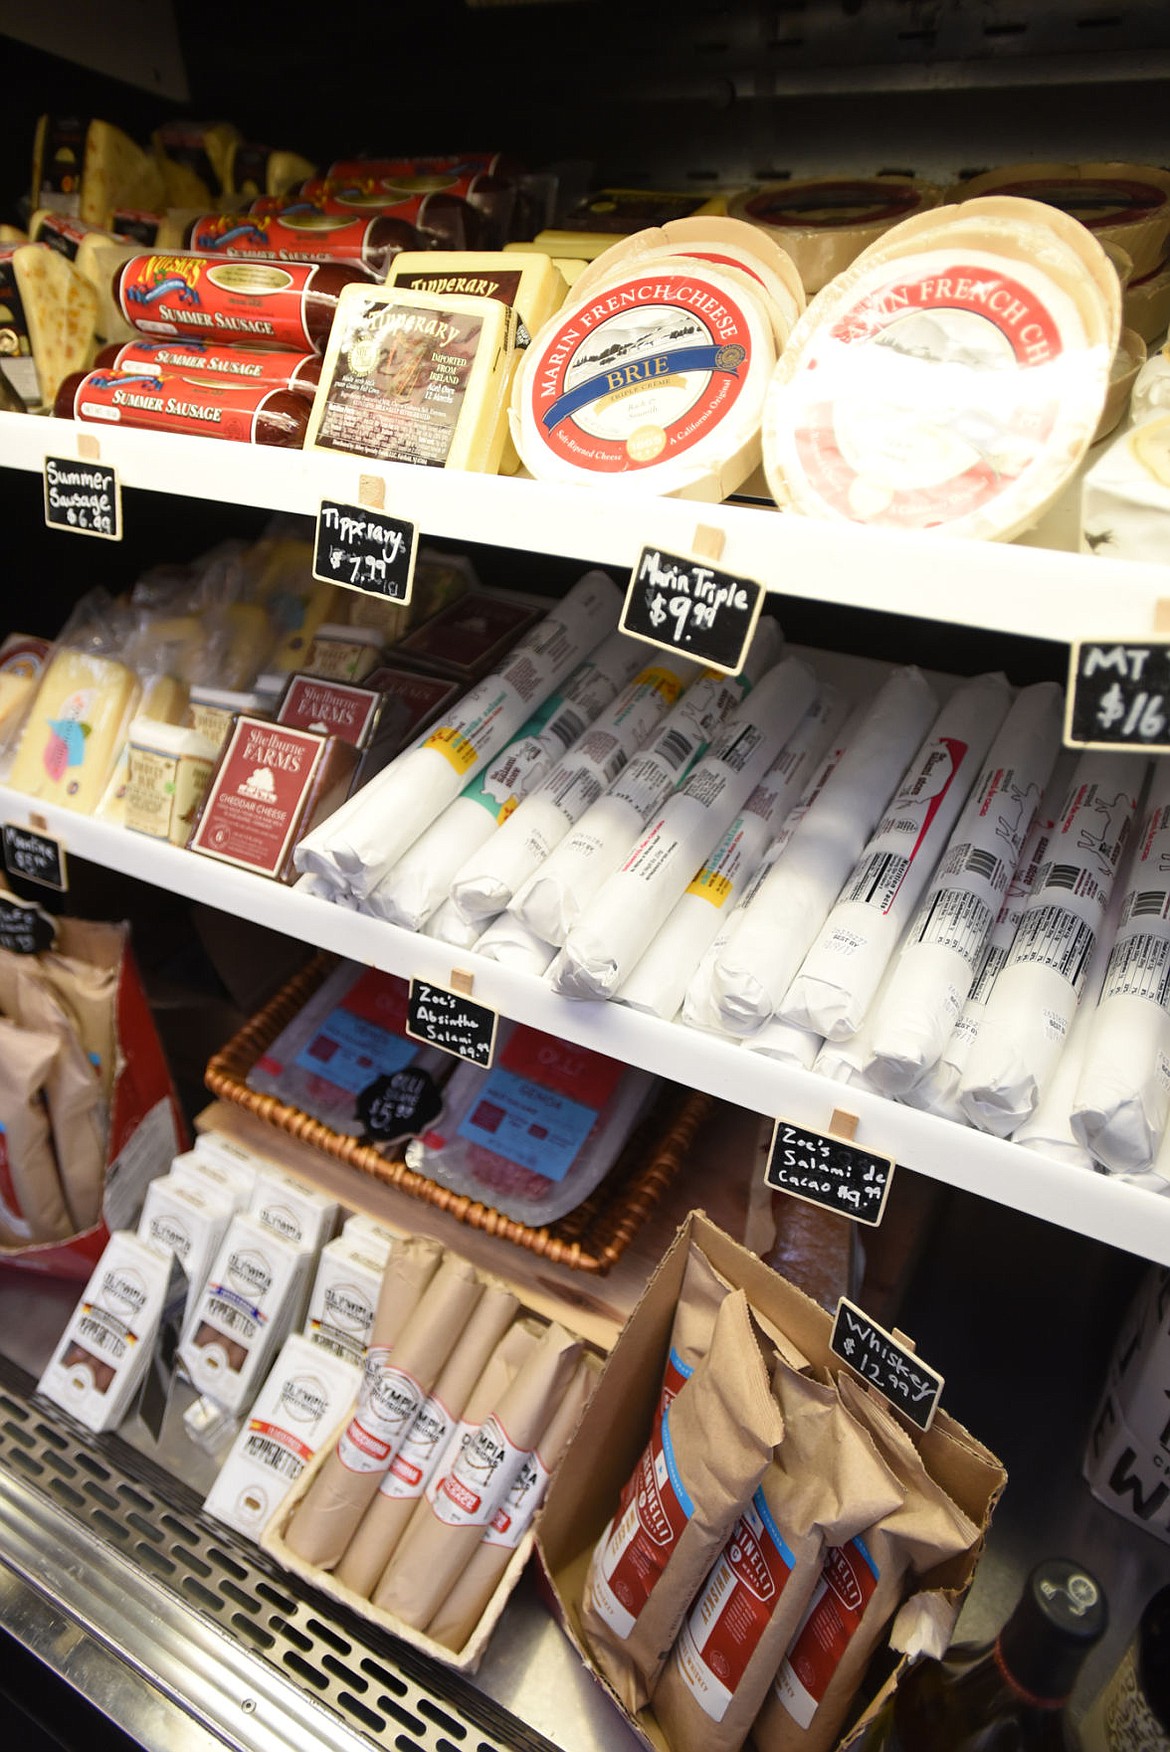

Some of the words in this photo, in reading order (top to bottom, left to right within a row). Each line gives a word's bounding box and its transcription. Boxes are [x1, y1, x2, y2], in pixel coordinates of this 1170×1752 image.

[919, 278, 1028, 325] FRENCH
[159, 305, 212, 327] SUMMER
[214, 312, 274, 335] SAUSAGE
[541, 328, 580, 398] MARIN
[580, 284, 671, 327] FRENCH
[675, 286, 739, 341] CHEESE
[155, 350, 205, 370] SUMMER
[207, 357, 263, 377] SAUSAGE
[431, 352, 467, 367] IMPORTED
[605, 355, 670, 391] BRIE
[112, 389, 164, 413] SUMMER
[165, 398, 222, 422] SAUSAGE
[677, 409, 713, 440] California
[708, 378, 732, 410] Original
[556, 428, 595, 460] Soft-Ripened
[595, 448, 623, 462] Cheese
[47, 462, 112, 491] Summer
[49, 491, 111, 516] Sausage
[691, 567, 748, 611] Triple
[1083, 646, 1150, 681] MT
[248, 729, 306, 756] Shelburne
[242, 744, 302, 773] FARMS
[219, 793, 256, 814] CHEDDAR
[255, 803, 288, 821] CHEESE
[890, 858, 909, 889] Nutrition
[879, 889, 893, 909] Facts
[419, 986, 456, 1008] Zoe's
[416, 1006, 479, 1028] Absinthe
[426, 1025, 472, 1044] Salami
[782, 1128, 830, 1157] Zoe's
[778, 1170, 831, 1192] Cacao
[783, 1150, 853, 1178] Salami
[863, 1165, 886, 1184] de
[845, 1311, 937, 1402] Whiskey
[702, 1565, 729, 1625] WHISKEY
